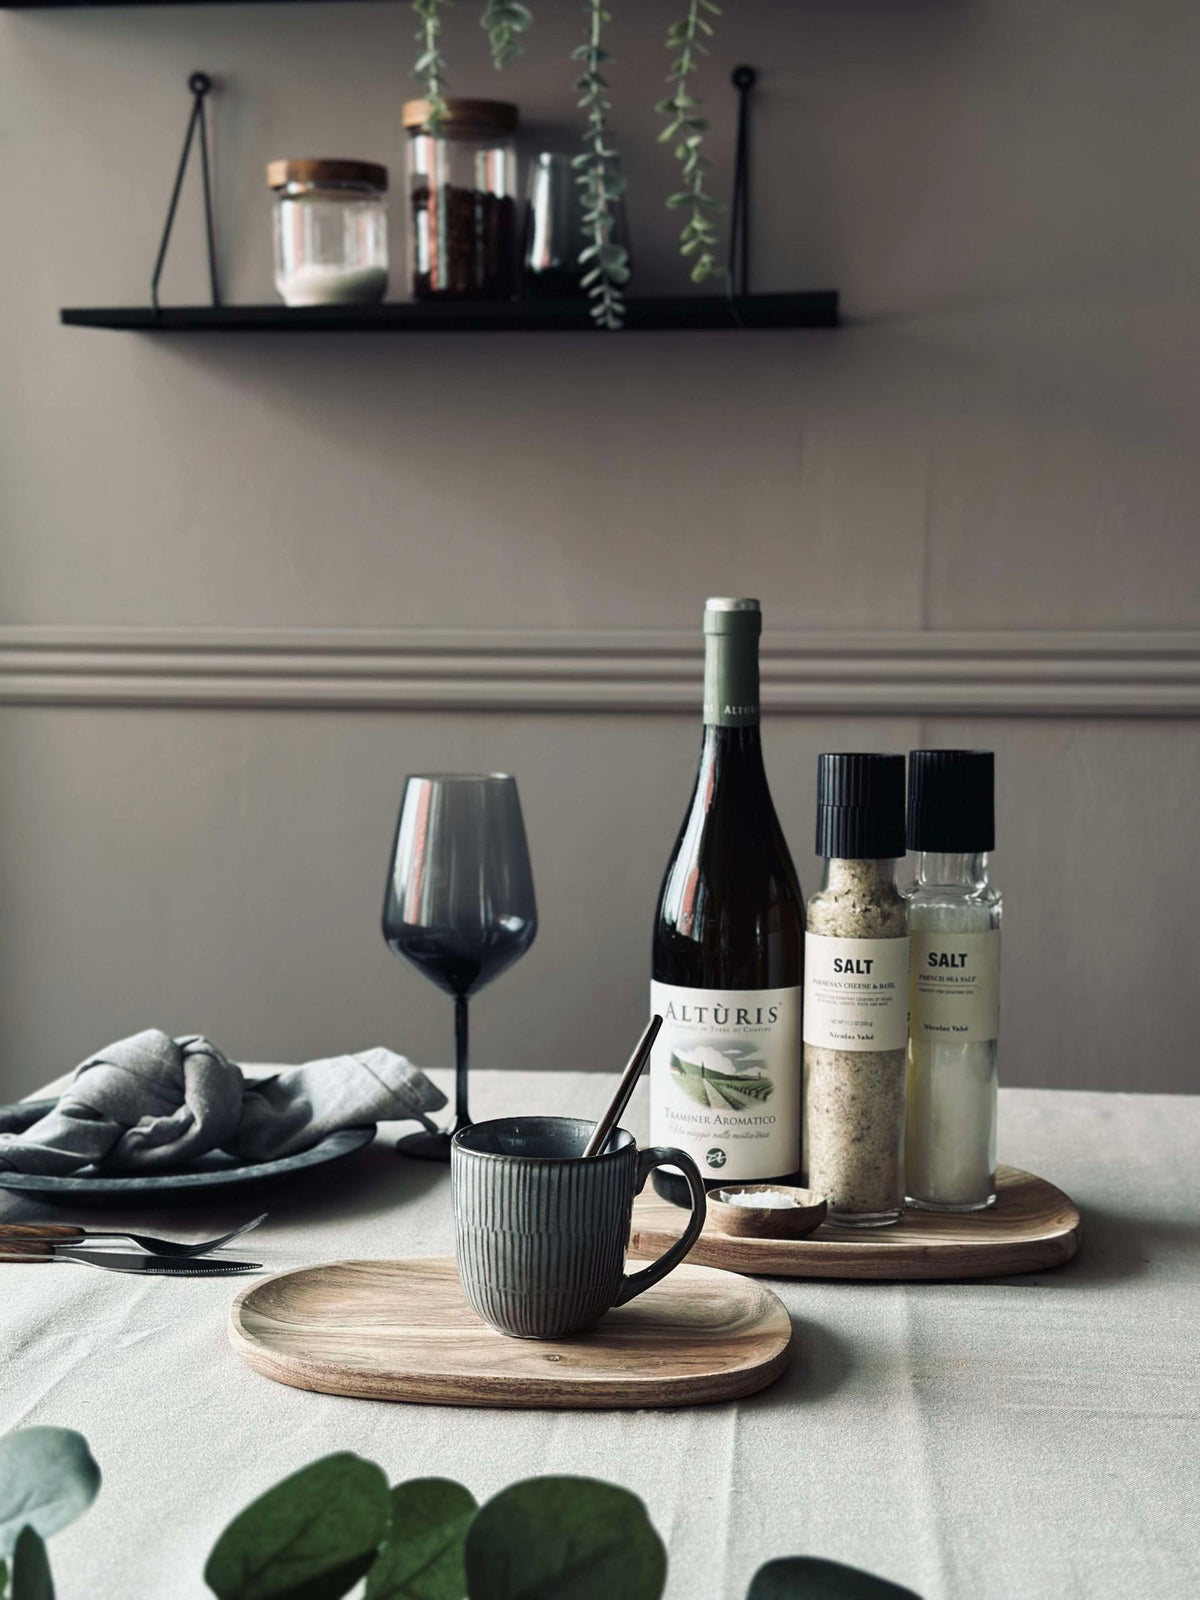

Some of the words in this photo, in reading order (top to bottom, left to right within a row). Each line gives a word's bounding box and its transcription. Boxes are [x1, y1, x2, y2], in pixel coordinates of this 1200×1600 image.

[833, 958, 874, 975] SALT
[928, 952, 968, 968] SALT
[665, 1001, 778, 1025] ALTÙRIS
[664, 1107, 711, 1124] TRAMINER
[713, 1115, 776, 1126] AROMATICO
